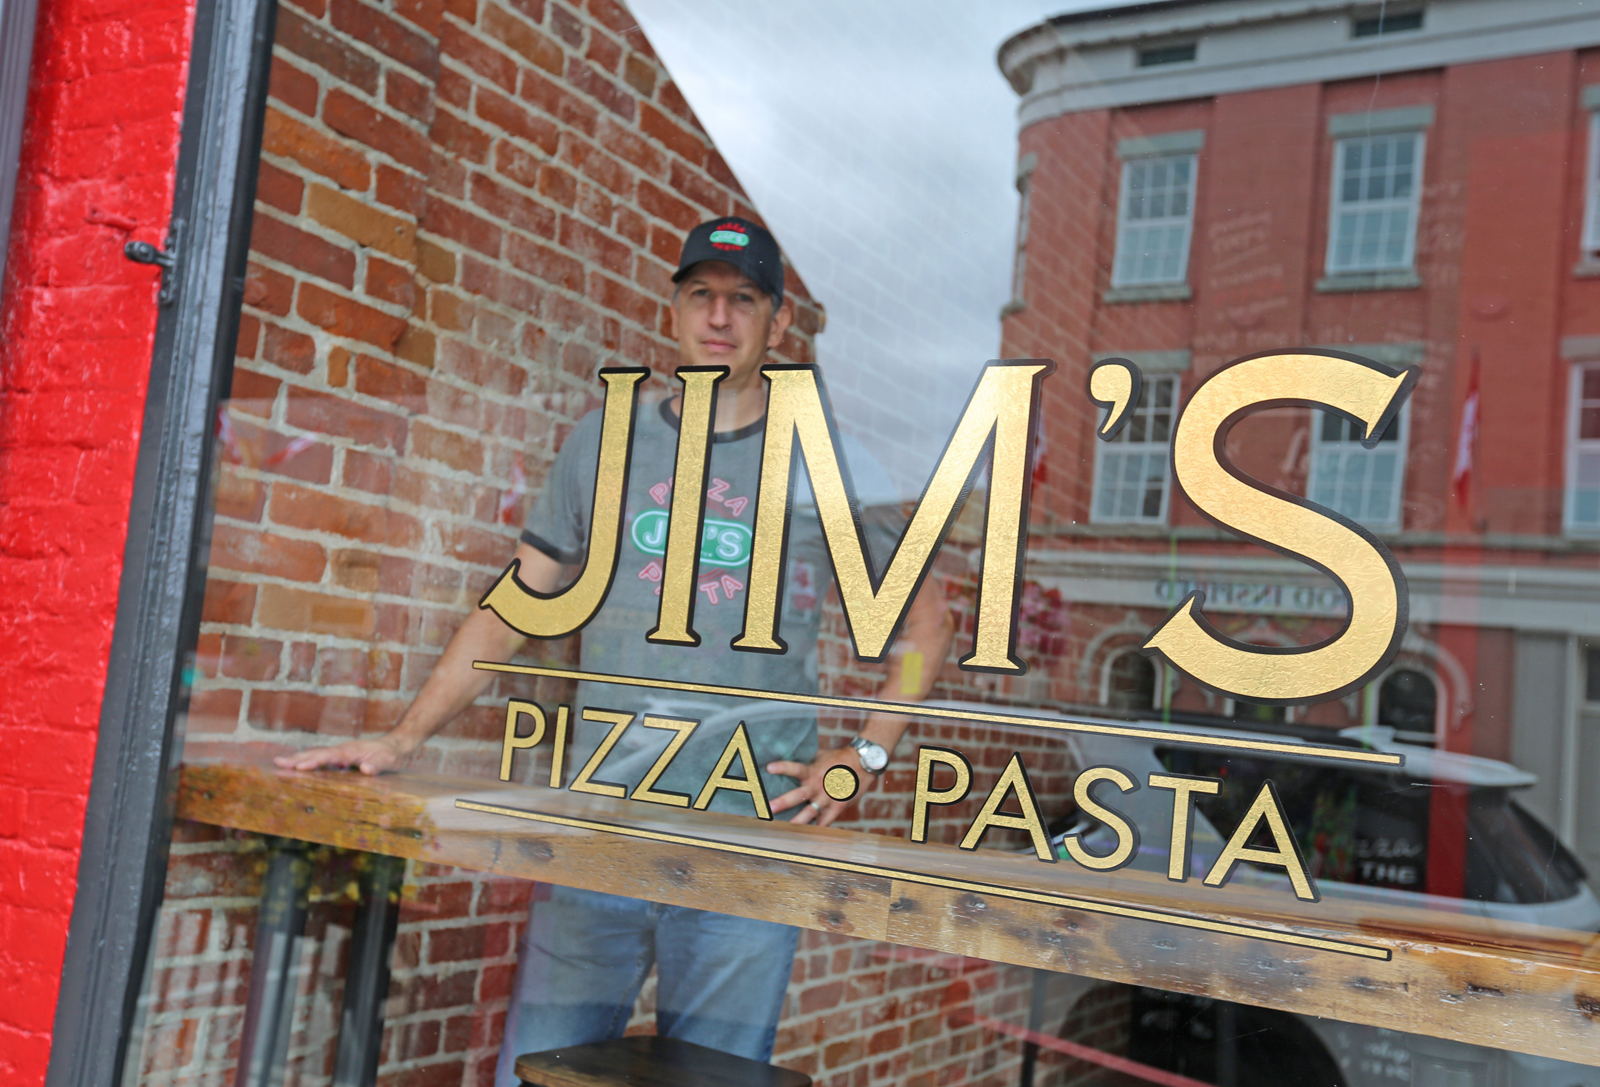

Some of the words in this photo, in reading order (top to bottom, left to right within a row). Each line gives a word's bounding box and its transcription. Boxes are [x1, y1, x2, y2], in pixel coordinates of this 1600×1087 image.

[648, 476, 749, 517] PZA
[479, 348, 1420, 704] JIM'S
[642, 517, 743, 560] J'S
[637, 561, 744, 605] PTA
[498, 698, 772, 821] PIZZA
[909, 744, 1321, 903] PASTA
